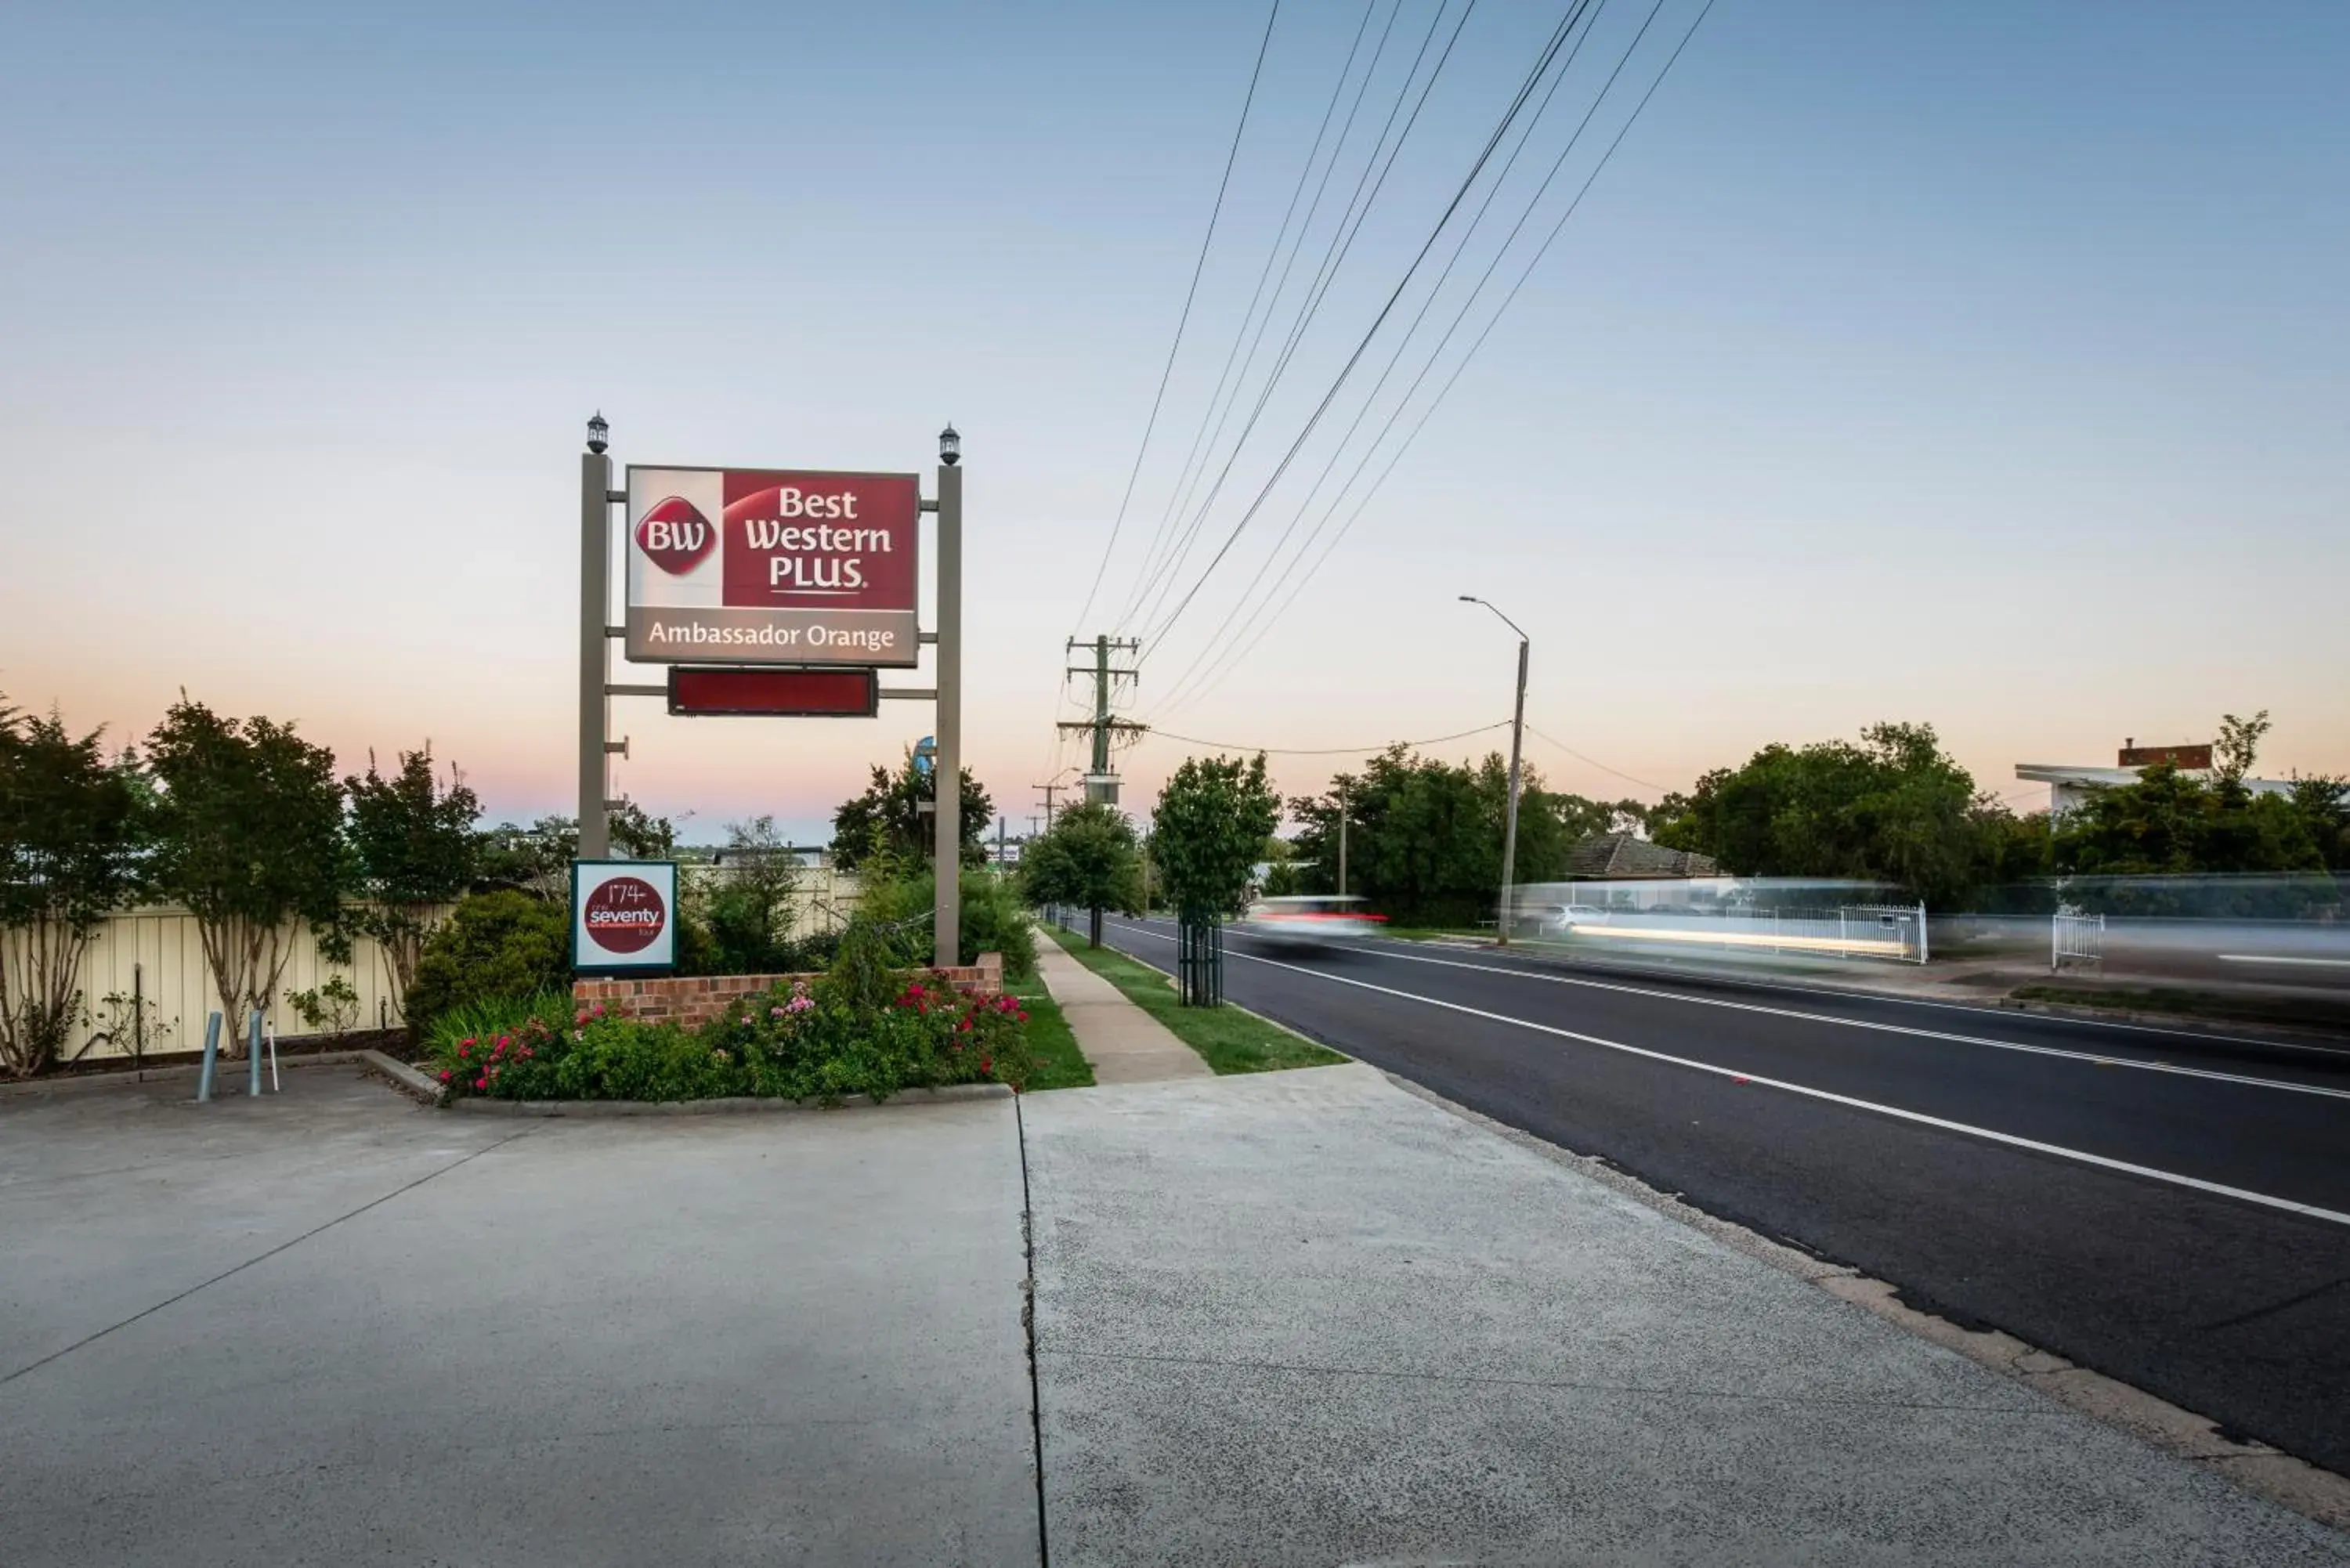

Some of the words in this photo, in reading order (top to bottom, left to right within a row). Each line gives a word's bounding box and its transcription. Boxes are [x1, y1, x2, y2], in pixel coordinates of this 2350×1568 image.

[779, 487, 858, 520] Best
[647, 520, 705, 551] BW
[745, 518, 891, 553] Western
[770, 556, 862, 588] PLUS
[648, 621, 801, 645] Ambassador
[806, 625, 895, 652] Orange
[608, 883, 647, 904] 174
[591, 908, 660, 927] seventy
